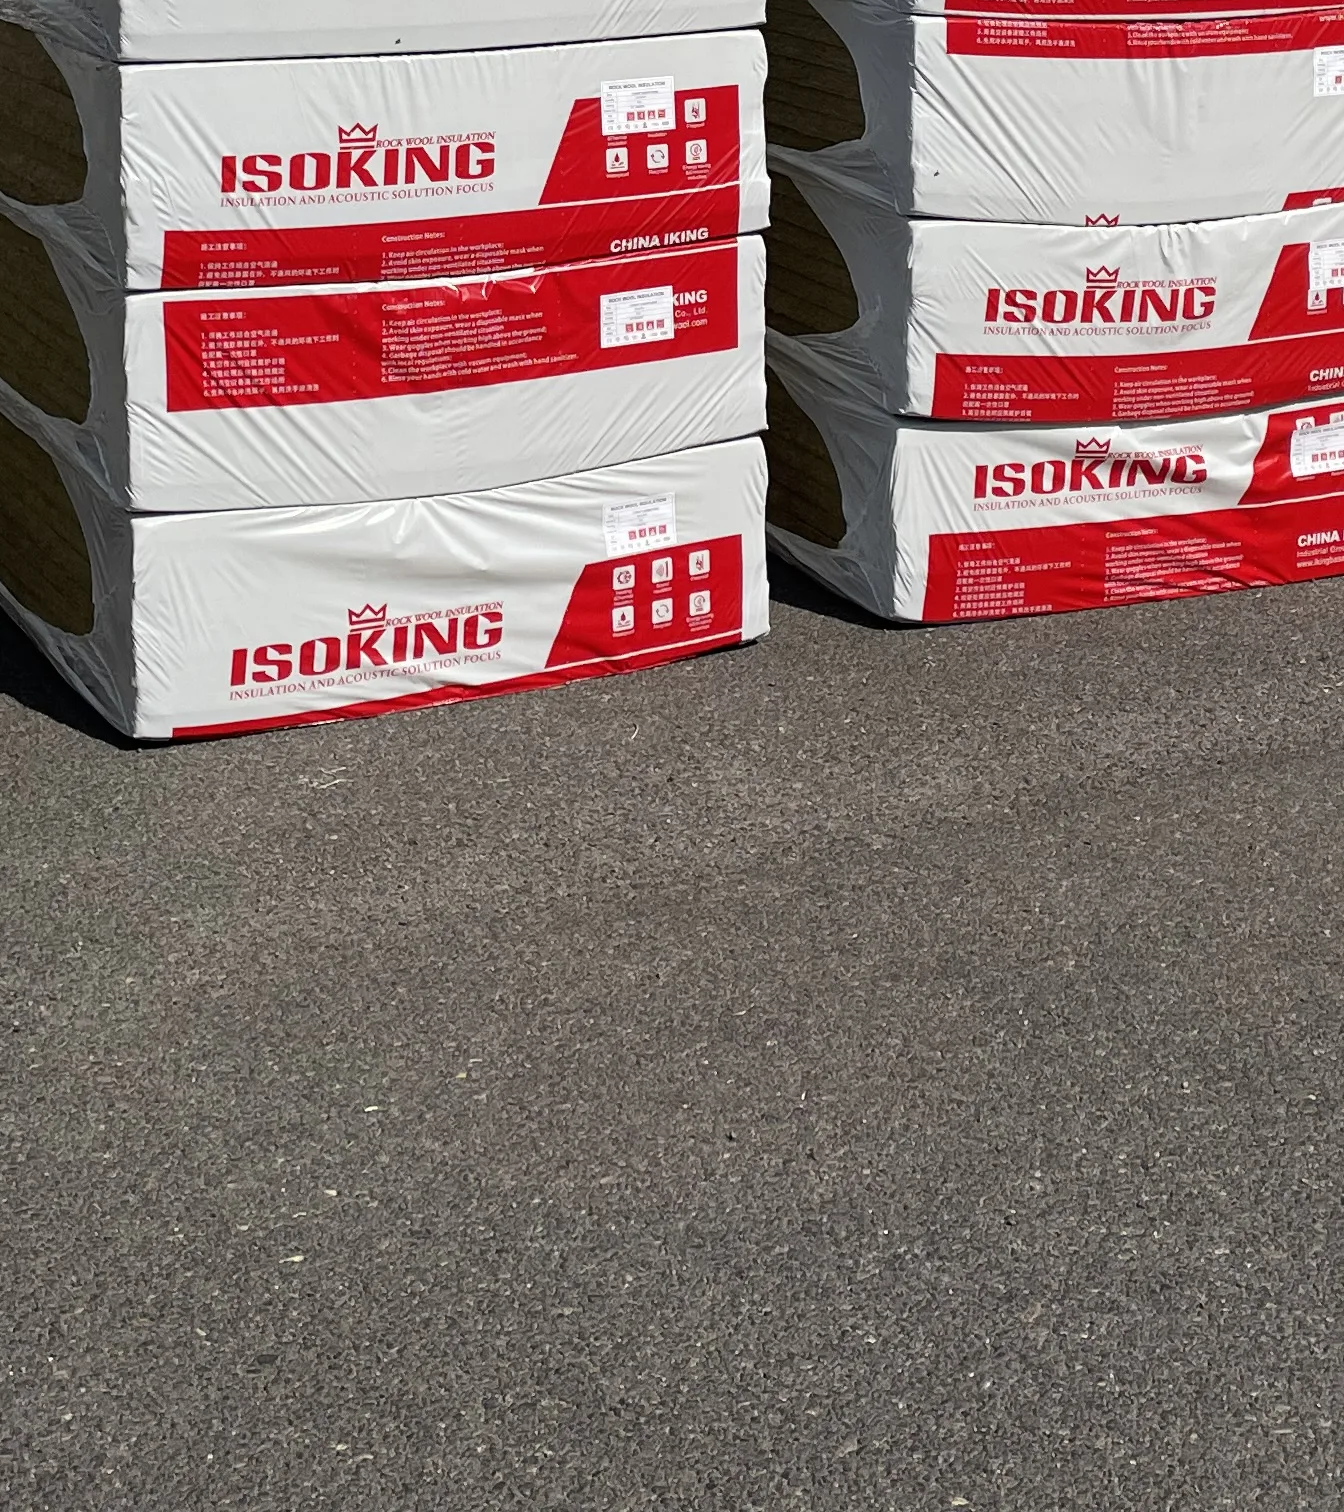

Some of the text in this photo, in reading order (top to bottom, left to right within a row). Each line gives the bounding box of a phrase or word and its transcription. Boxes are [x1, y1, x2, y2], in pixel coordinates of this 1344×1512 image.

[376, 131, 495, 149] ROCK WOOL INSULATION
[221, 141, 495, 193] ISOKING
[220, 182, 494, 208] INSULATION AND ACOUSTIC SOLUTION FOCUS
[610, 227, 708, 252] CHINA IKING
[673, 290, 707, 307] KING
[985, 286, 1216, 324] ISOKING
[983, 322, 1211, 336] INSULATION AND ACOUSTIC SOLUTION FOCUS
[974, 455, 1207, 499] ISOKING
[973, 485, 1203, 511] INSULATION AND ACOUSTIC SOLUTION FOCUS
[1297, 530, 1340, 547] CHINA
[385, 601, 503, 628] ROCK WOOL INSULATION
[230, 612, 503, 686] ISOKING
[229, 651, 501, 700] INSULATION AND ACOUSTIC SOLUTION FOCUS
